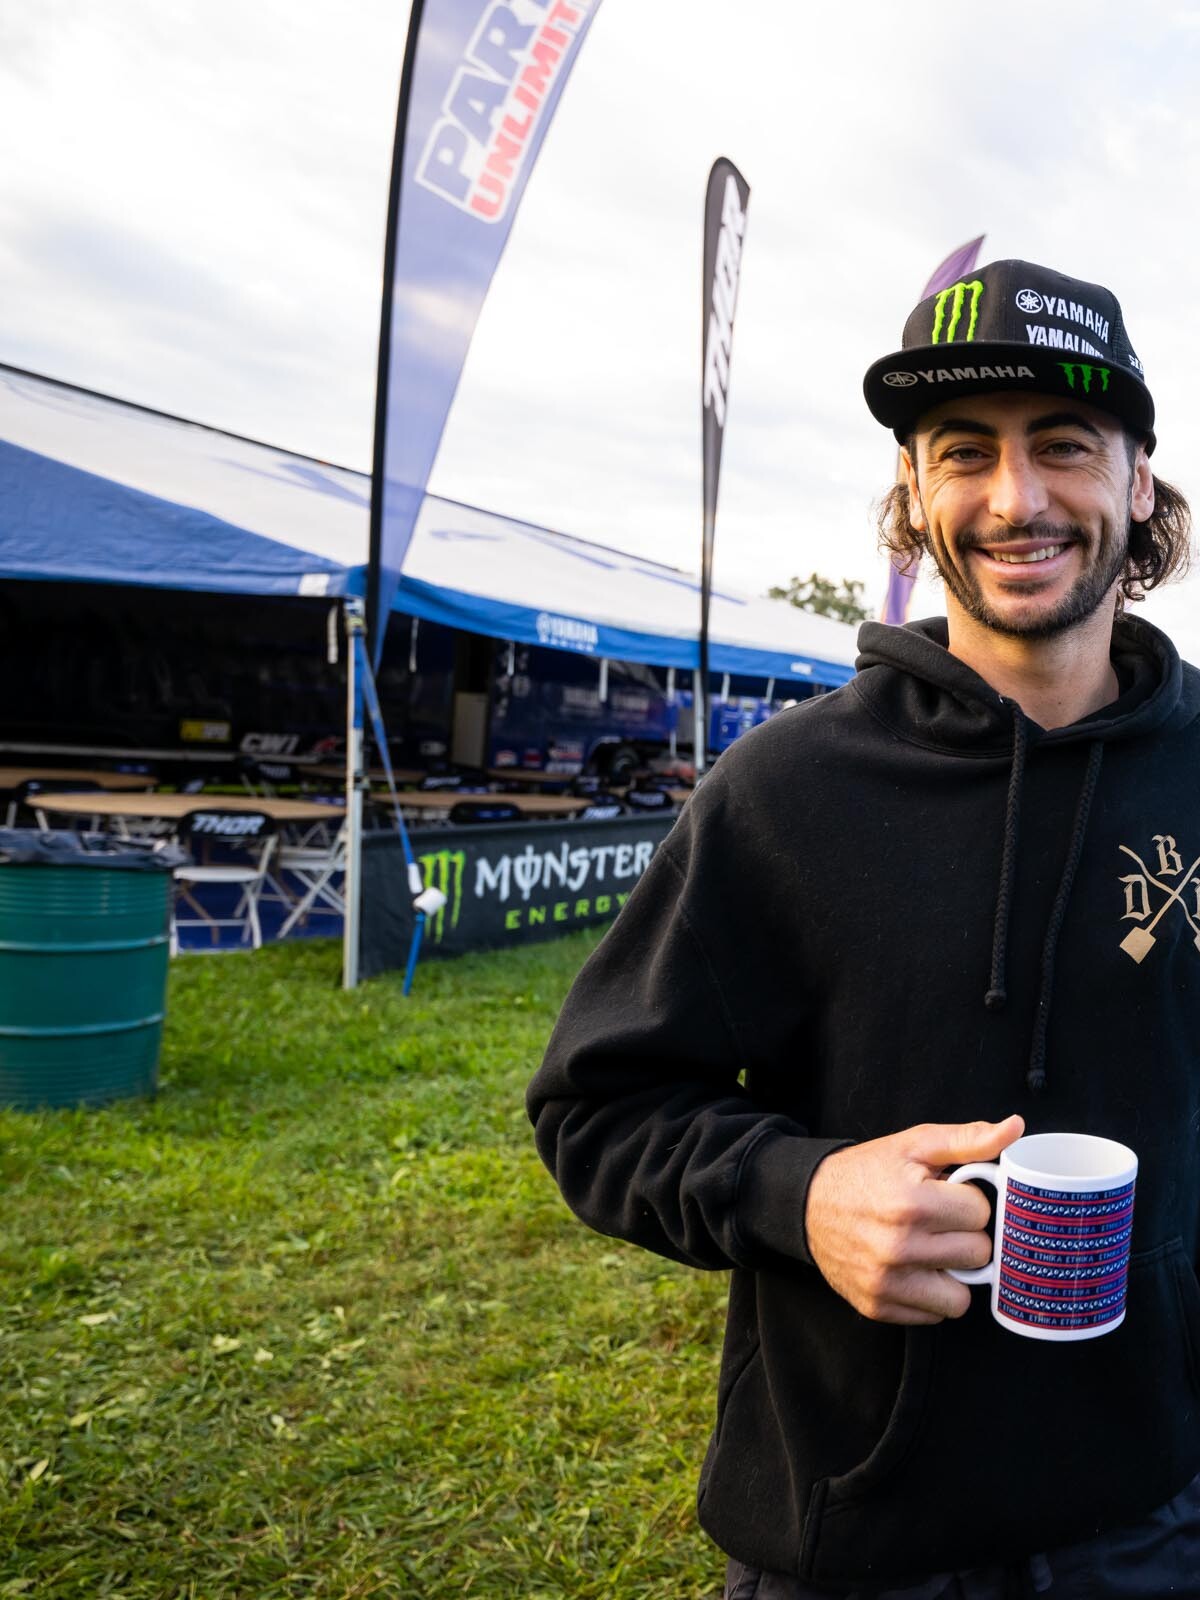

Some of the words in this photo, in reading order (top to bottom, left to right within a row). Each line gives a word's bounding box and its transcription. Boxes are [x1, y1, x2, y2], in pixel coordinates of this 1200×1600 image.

[414, 0, 548, 206] PAR
[1042, 295, 1110, 344] YAMAHA
[916, 365, 1036, 384] YAMAHA
[192, 814, 265, 835] THOR
[475, 841, 653, 902] MONSTER
[1151, 834, 1184, 876] B
